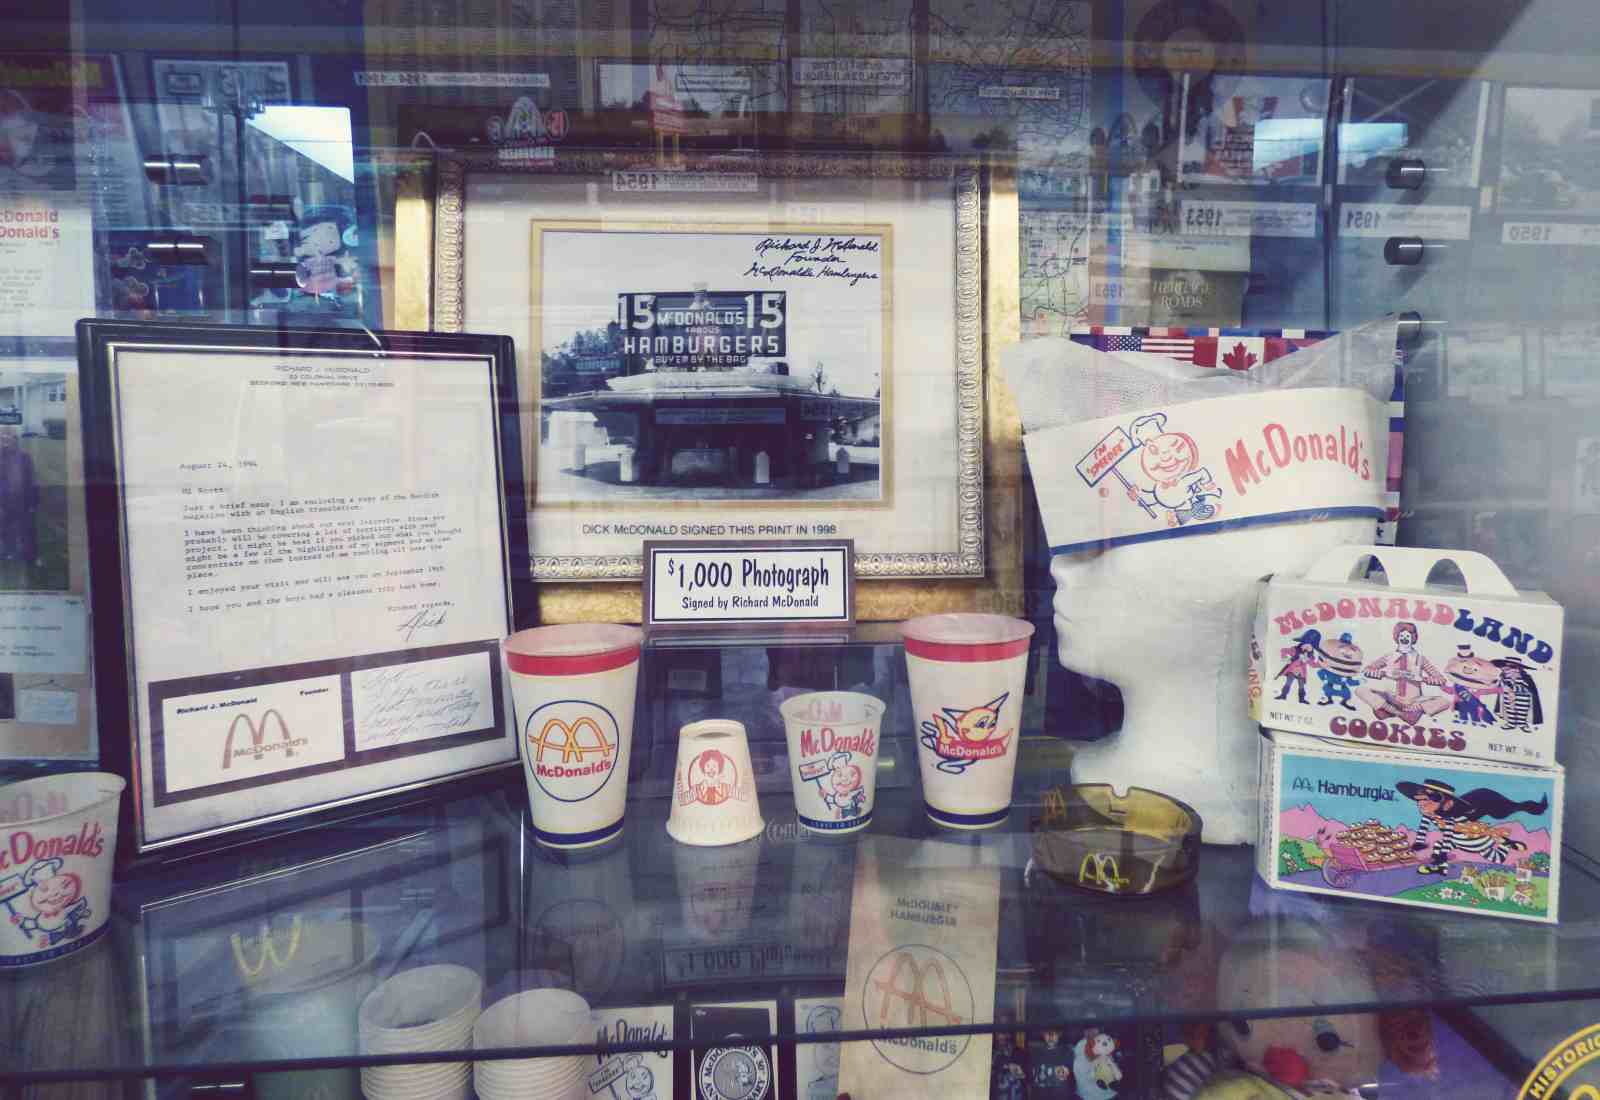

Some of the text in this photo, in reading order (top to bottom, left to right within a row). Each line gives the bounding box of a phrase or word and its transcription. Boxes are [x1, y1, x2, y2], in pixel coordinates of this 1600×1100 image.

[619, 294, 655, 330] 15
[744, 292, 785, 329] 15
[624, 335, 779, 354] HAMBURGERS
[1224, 423, 1371, 497] McDonald's
[582, 524, 610, 535] DICK
[613, 524, 678, 535] McDONALD
[680, 524, 727, 535] SIGNED
[729, 524, 756, 535] THIS
[758, 524, 793, 535] PRINT
[796, 524, 808, 535] IN
[668, 557, 829, 593] $1,000 Photograph
[681, 595, 819, 610] Signed by Richard McDonald
[800, 727, 875, 758] McDonald's
[1329, 716, 1467, 752] COOKIES
[233, 737, 309, 759] McDonald's
[943, 743, 1003, 757] McDonald's
[536, 760, 612, 778] McDonald's
[1318, 780, 1396, 801] Hamburglar
